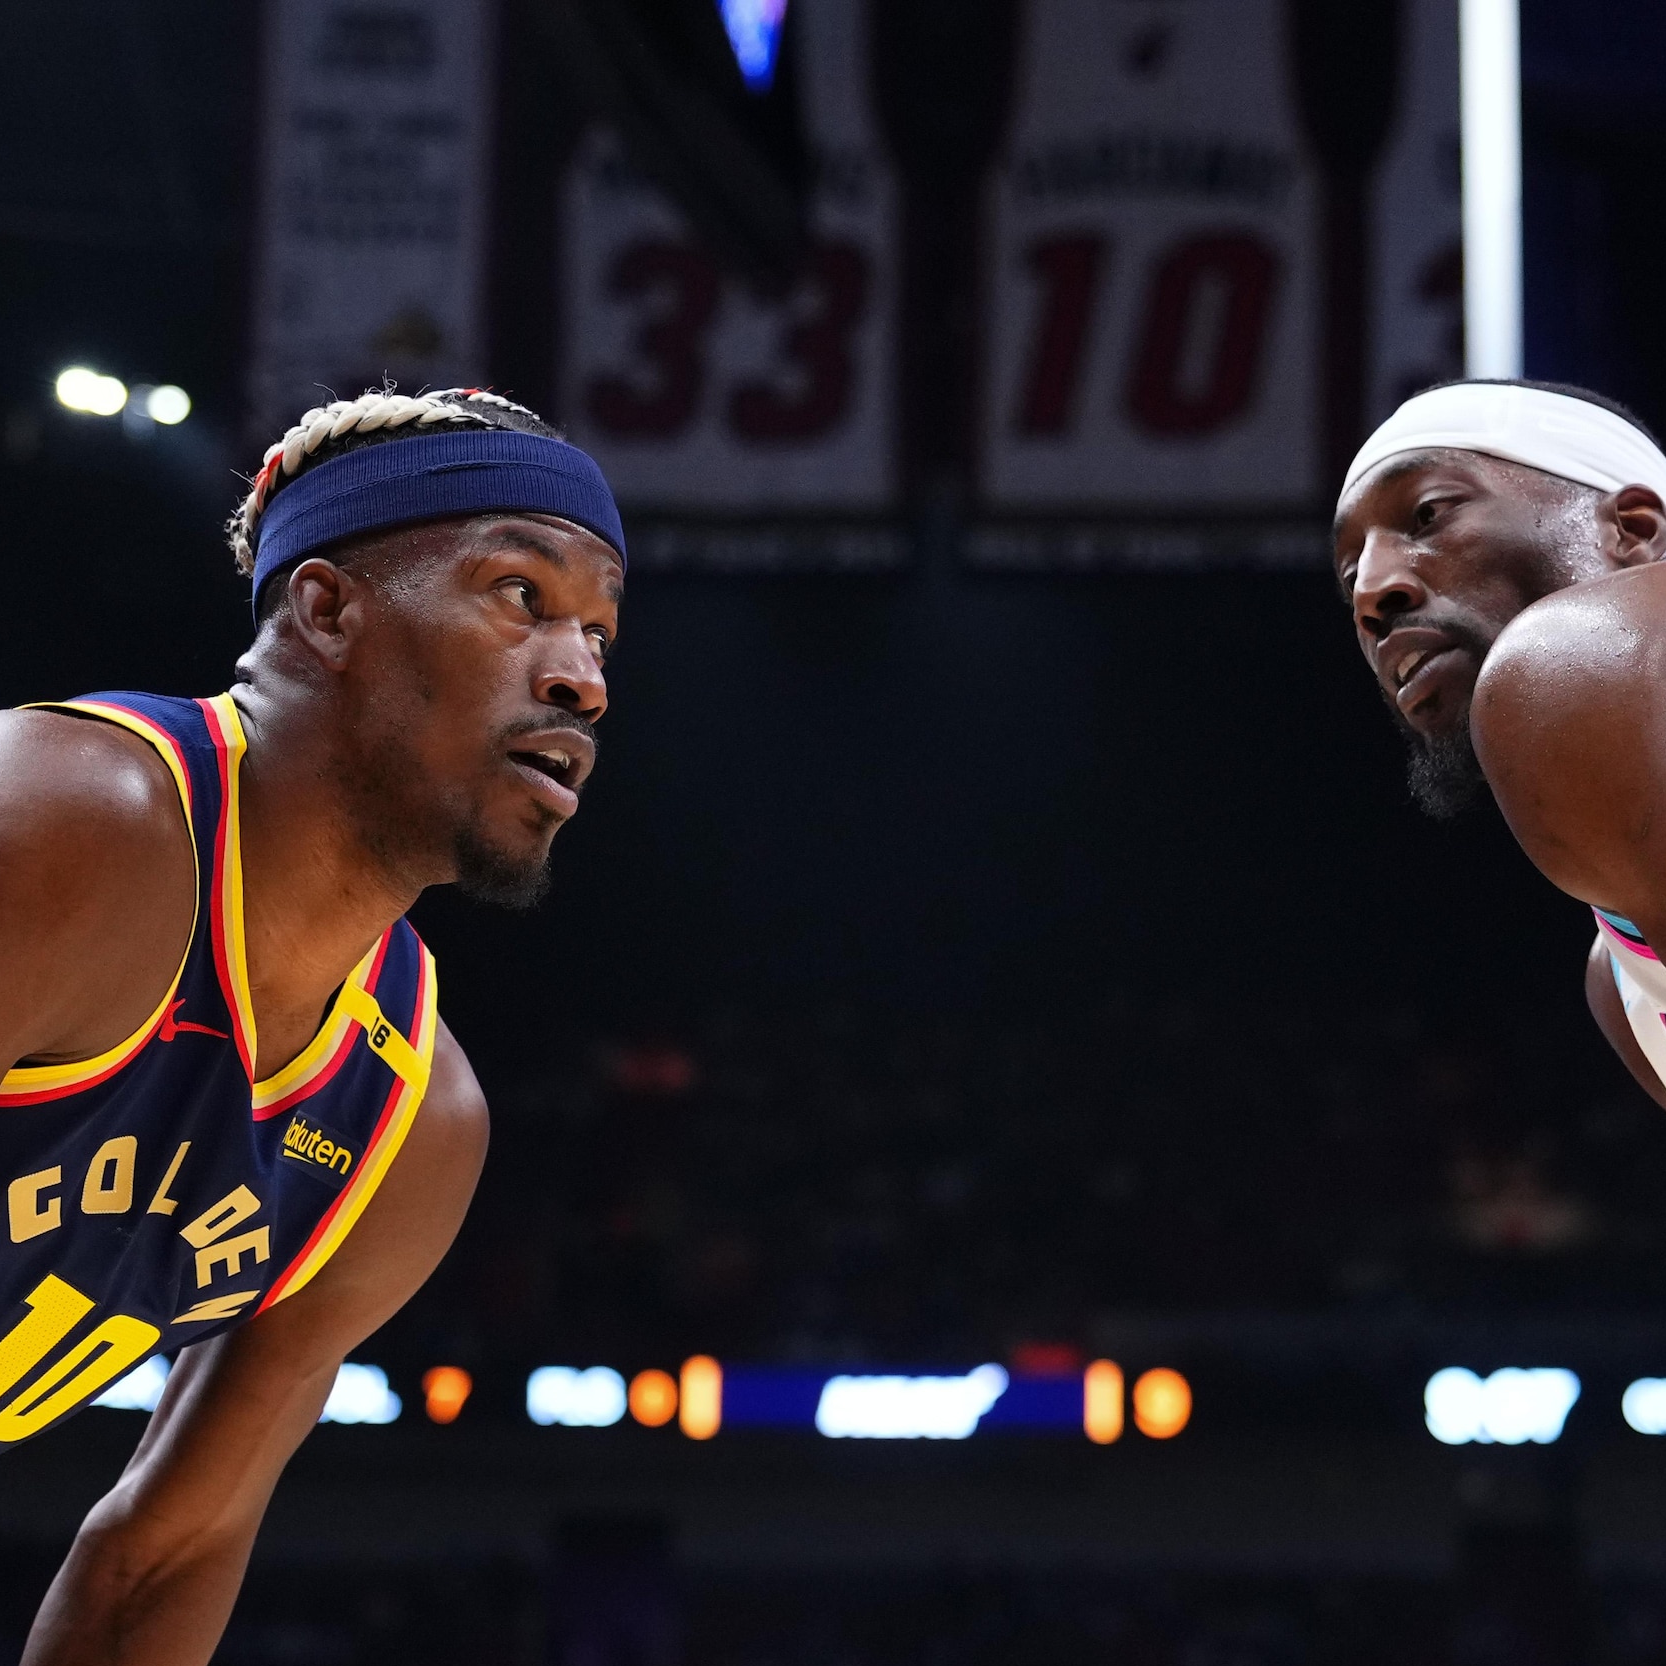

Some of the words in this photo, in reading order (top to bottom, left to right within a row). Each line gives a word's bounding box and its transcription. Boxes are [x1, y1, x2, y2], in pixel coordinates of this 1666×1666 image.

[585, 232, 871, 444] 33
[1013, 226, 1286, 440] 10
[7, 1135, 271, 1325] GOLDEN
